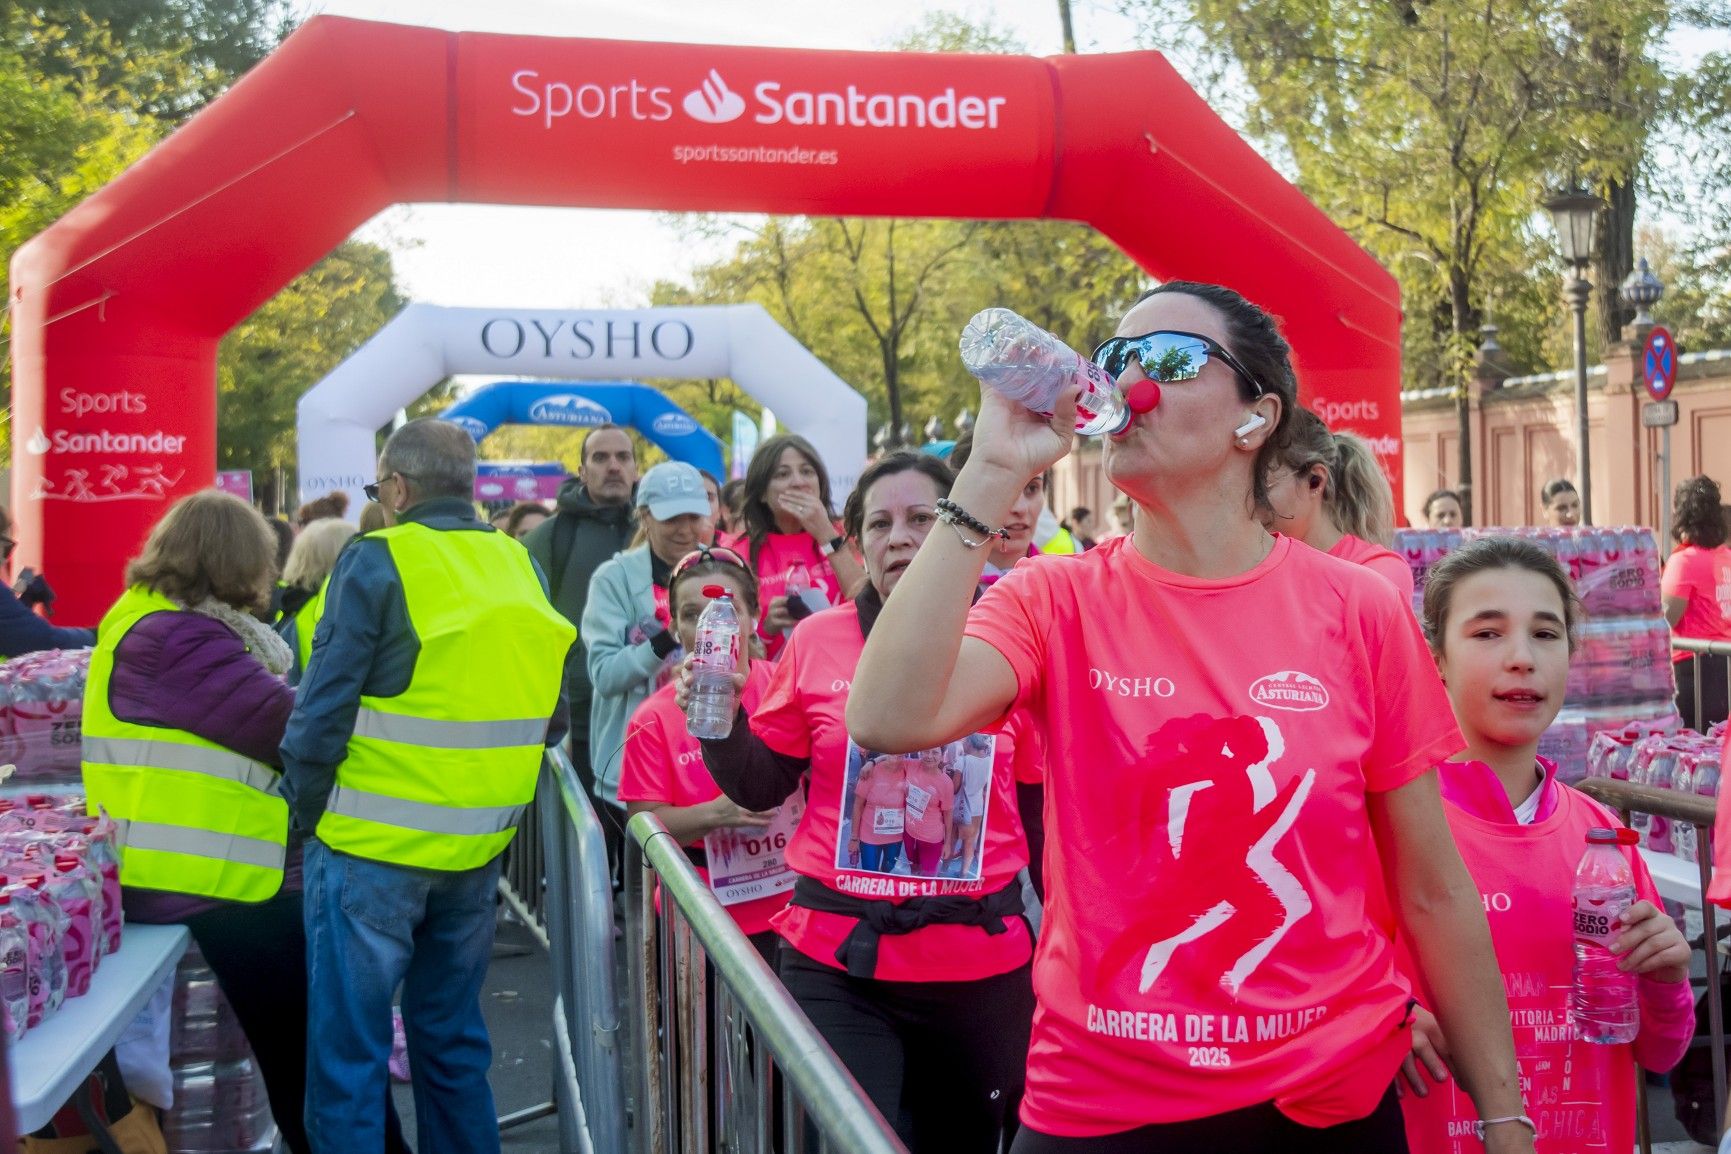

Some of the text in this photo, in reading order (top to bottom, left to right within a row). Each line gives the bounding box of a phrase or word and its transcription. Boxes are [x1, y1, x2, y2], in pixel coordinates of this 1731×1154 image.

[511, 69, 1007, 130] Sports Santander
[673, 145, 838, 166] sportssantander.es
[481, 317, 695, 361] OYSHO
[59, 386, 148, 419] Sports
[1311, 396, 1380, 425] Sports
[52, 429, 187, 455] Santander
[307, 475, 365, 489] OYSHO
[1088, 668, 1175, 698] OYSHO
[1256, 684, 1324, 705] ASTURIANA
[726, 884, 763, 899] OYSHO
[835, 874, 986, 897] CARRERA DE LA MUJER
[1087, 1003, 1179, 1042] CARRERA
[1185, 1014, 1215, 1042] DE
[1221, 1014, 1249, 1043] LA
[1187, 1046, 1231, 1067] 2025
